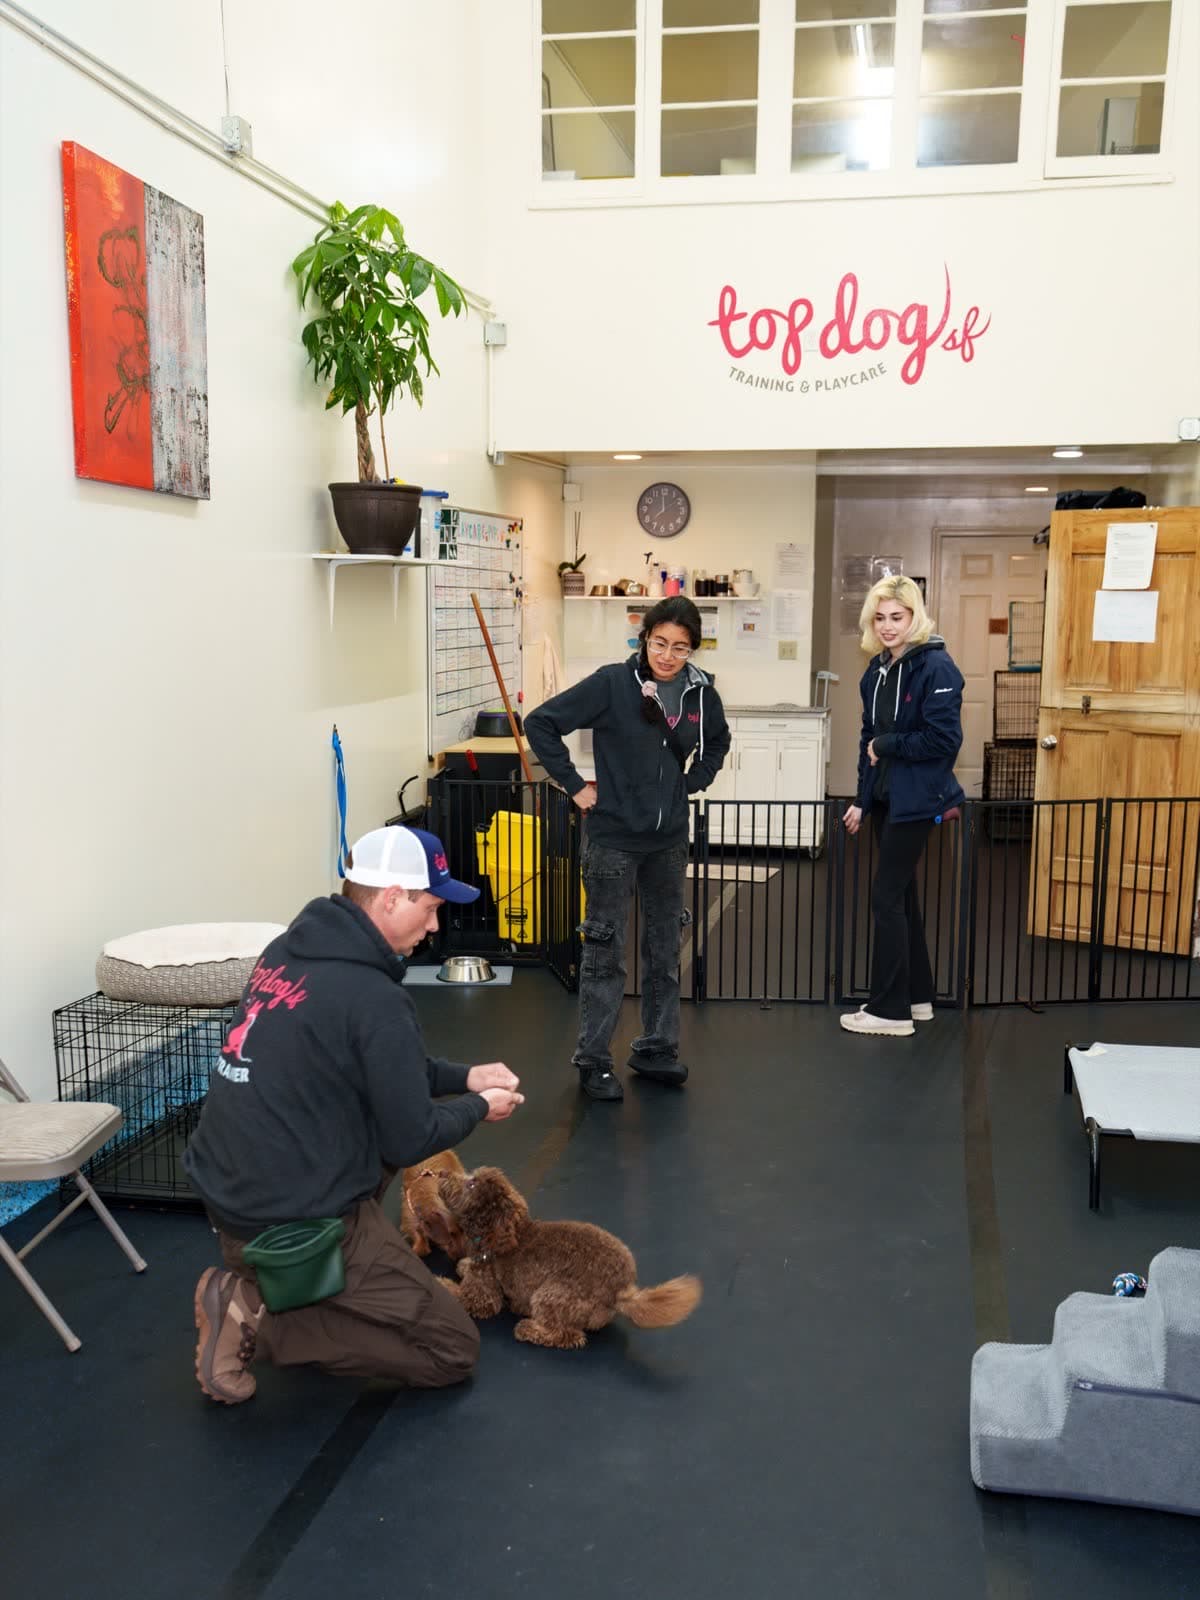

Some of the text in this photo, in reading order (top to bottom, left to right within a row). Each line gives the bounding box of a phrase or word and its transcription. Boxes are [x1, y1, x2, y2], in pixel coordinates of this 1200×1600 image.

[707, 260, 992, 385] top dog sf
[729, 362, 888, 393] TRAINING & PLAYCARE
